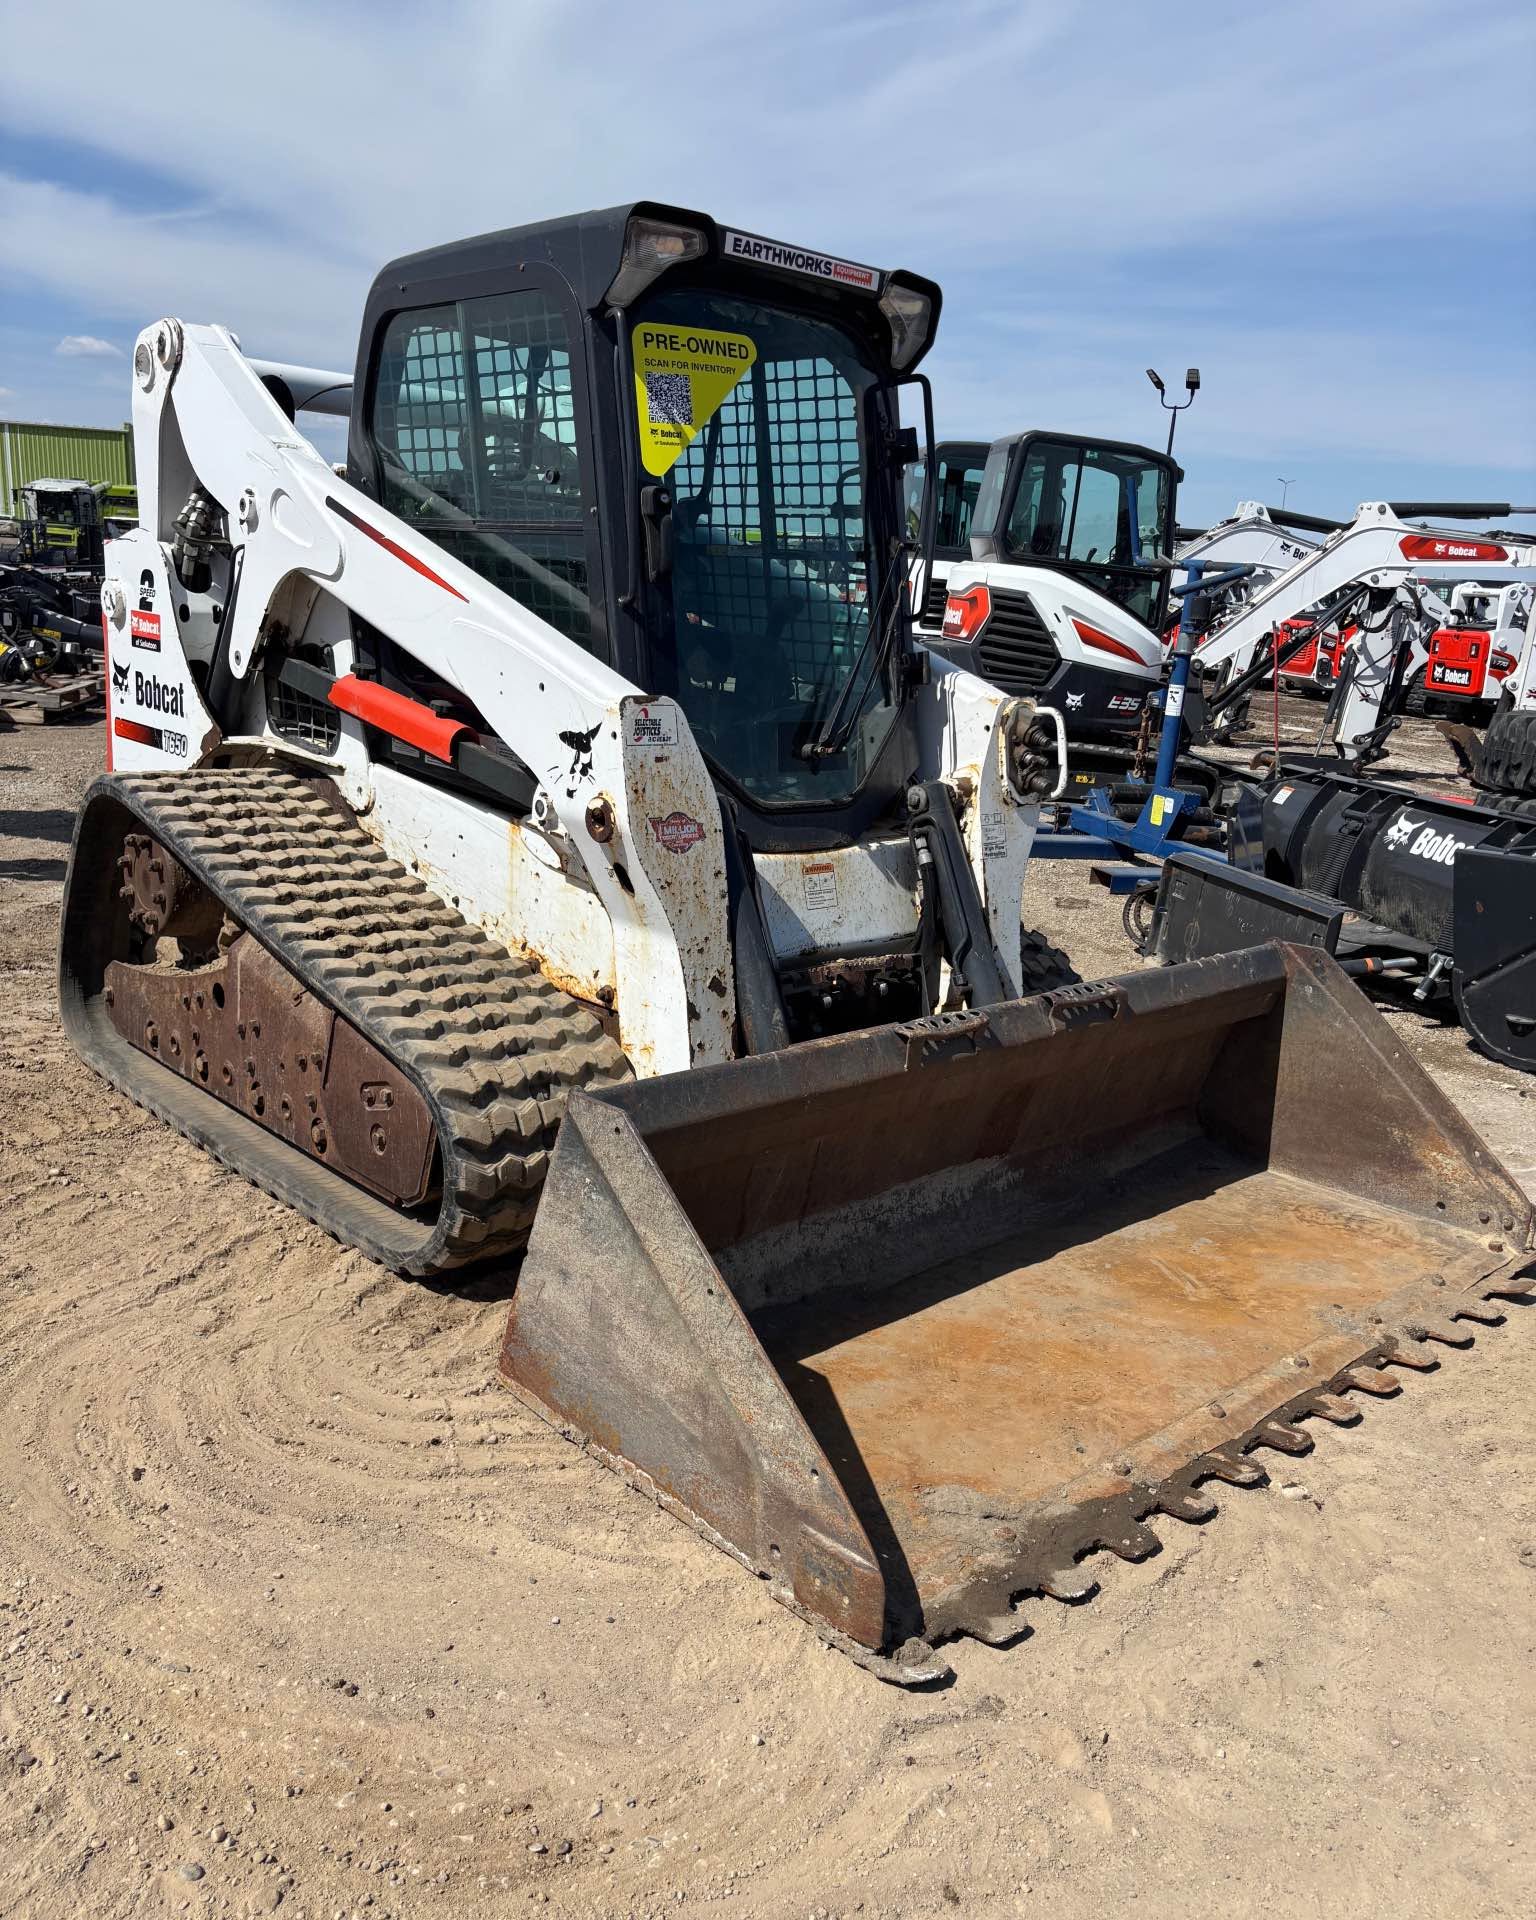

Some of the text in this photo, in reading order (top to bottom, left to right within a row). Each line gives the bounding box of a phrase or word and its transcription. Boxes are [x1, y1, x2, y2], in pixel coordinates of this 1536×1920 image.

[732, 237, 871, 279] EARTHWORKS EQUIPMENT
[643, 332, 749, 360] PRE-OWNED
[644, 358, 736, 375] SCAN FOR INVENTORY
[660, 429, 682, 439] Bobcat
[1448, 546, 1477, 557] Bobcat
[139, 568, 154, 612] 2
[139, 587, 156, 598] SPEED
[139, 618, 160, 635] Bobcat
[1444, 669, 1469, 685] Bobcat
[135, 670, 185, 718] Bobcat
[1107, 695, 1142, 711] E35
[634, 718, 661, 726] SELECTABLE
[633, 726, 661, 737] JOYSTICKS
[163, 729, 188, 758] T650
